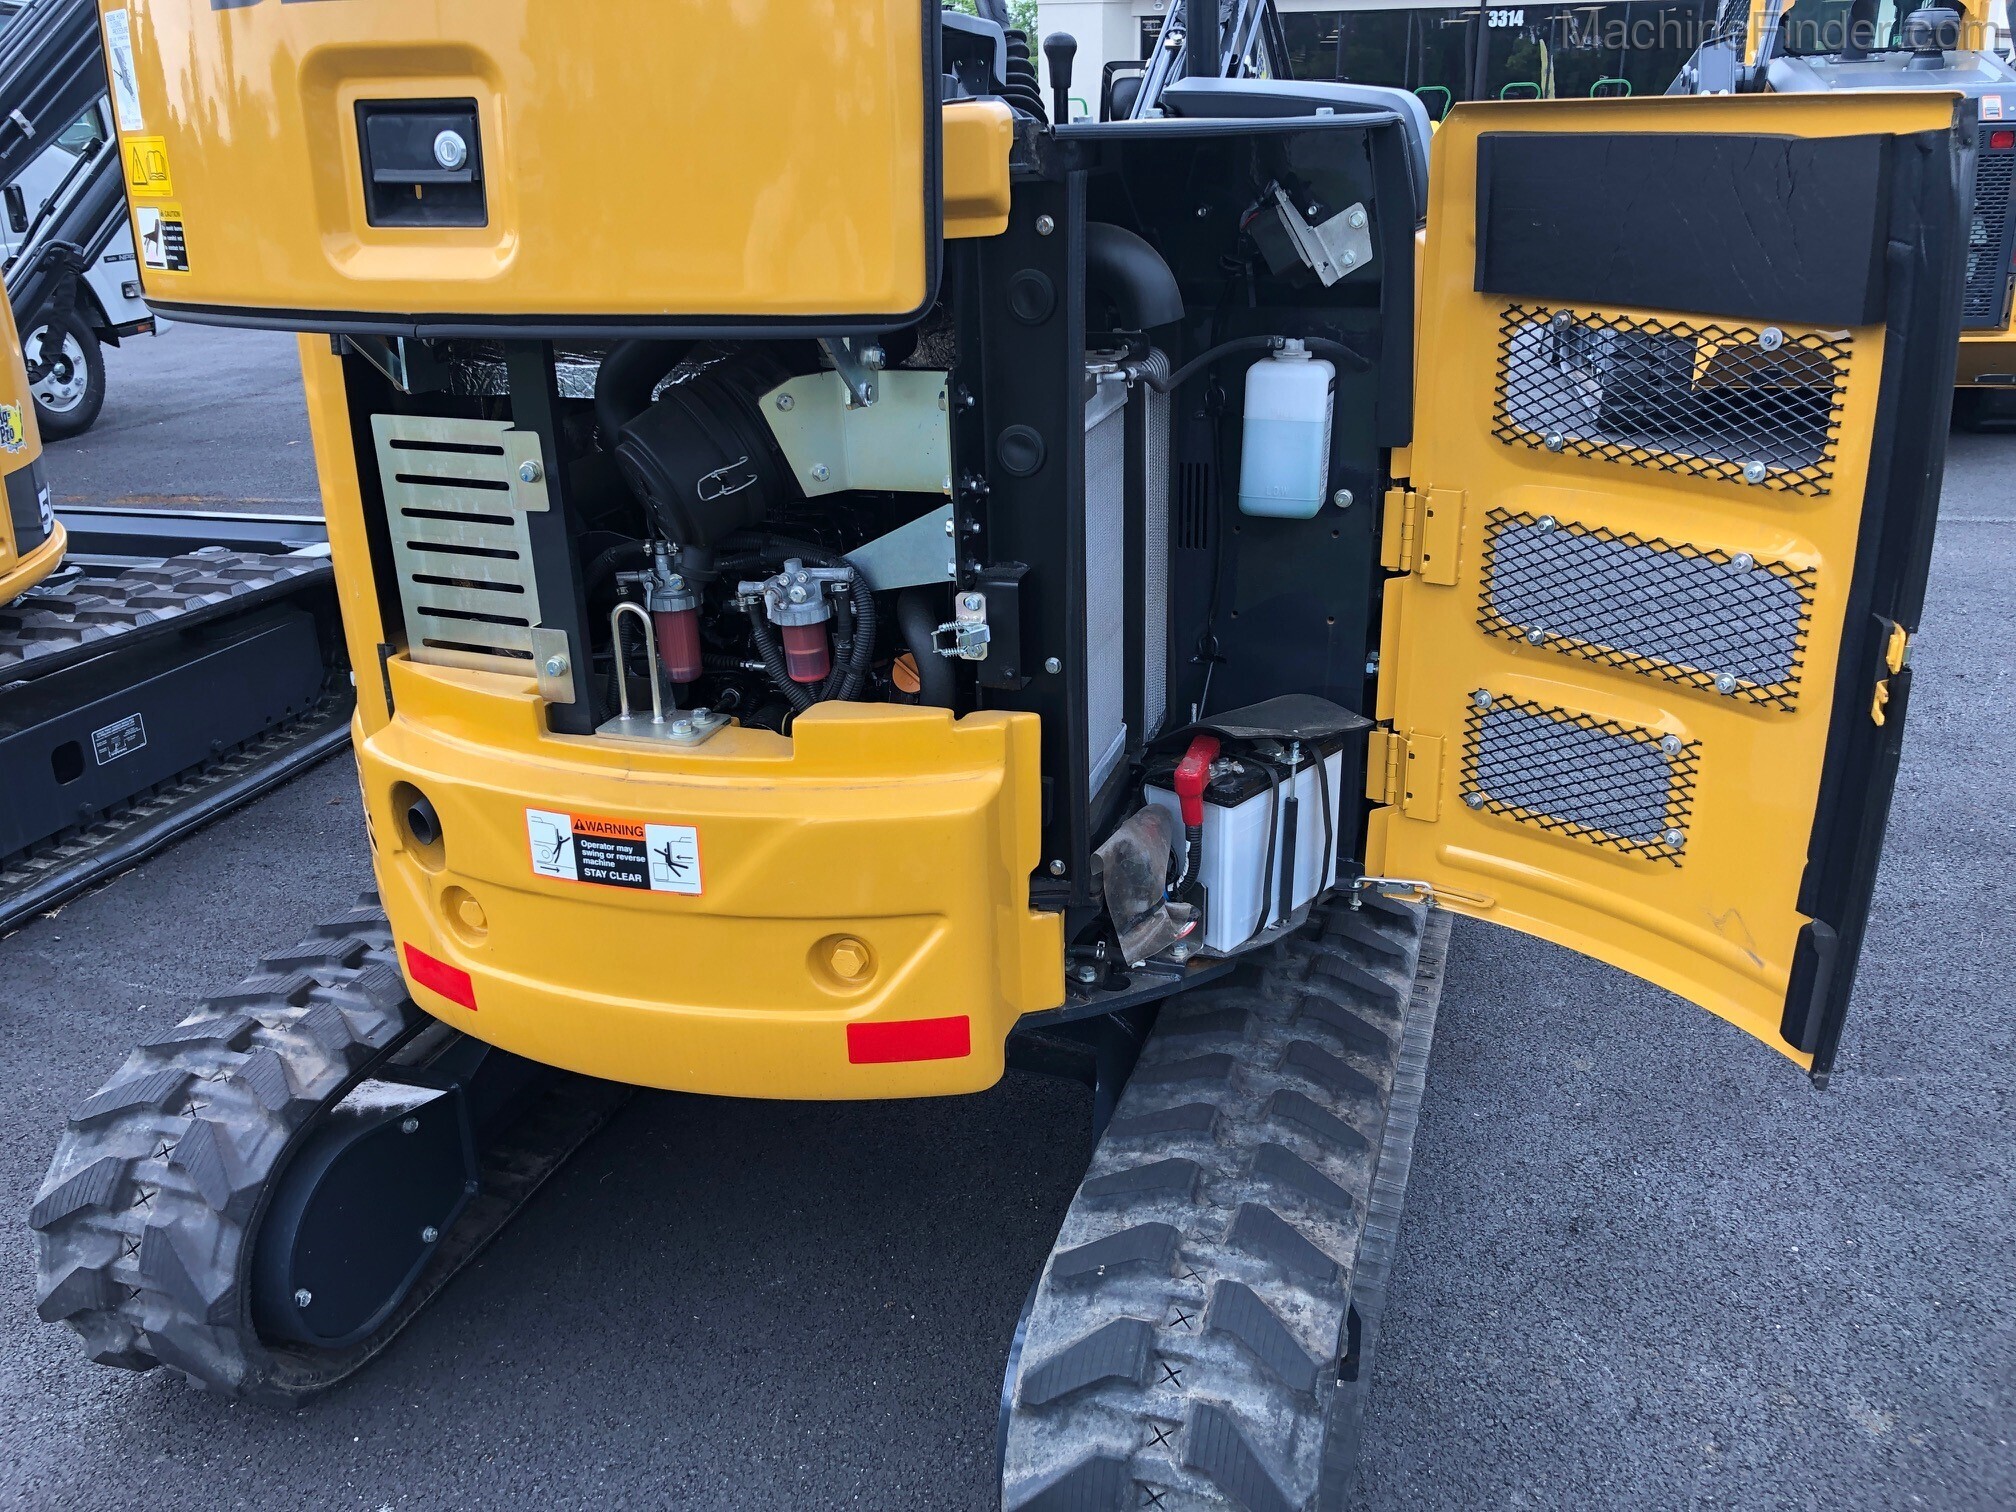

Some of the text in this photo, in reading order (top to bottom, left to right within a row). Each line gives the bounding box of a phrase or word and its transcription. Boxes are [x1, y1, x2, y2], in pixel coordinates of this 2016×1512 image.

[1488, 10, 1524, 27] 3314
[585, 821, 644, 837] WARNING
[581, 839, 633, 854] Operator may
[582, 849, 605, 859] swing
[616, 854, 646, 863] reverse
[583, 858, 616, 868] machine
[584, 868, 642, 883] STAY CLEAR
